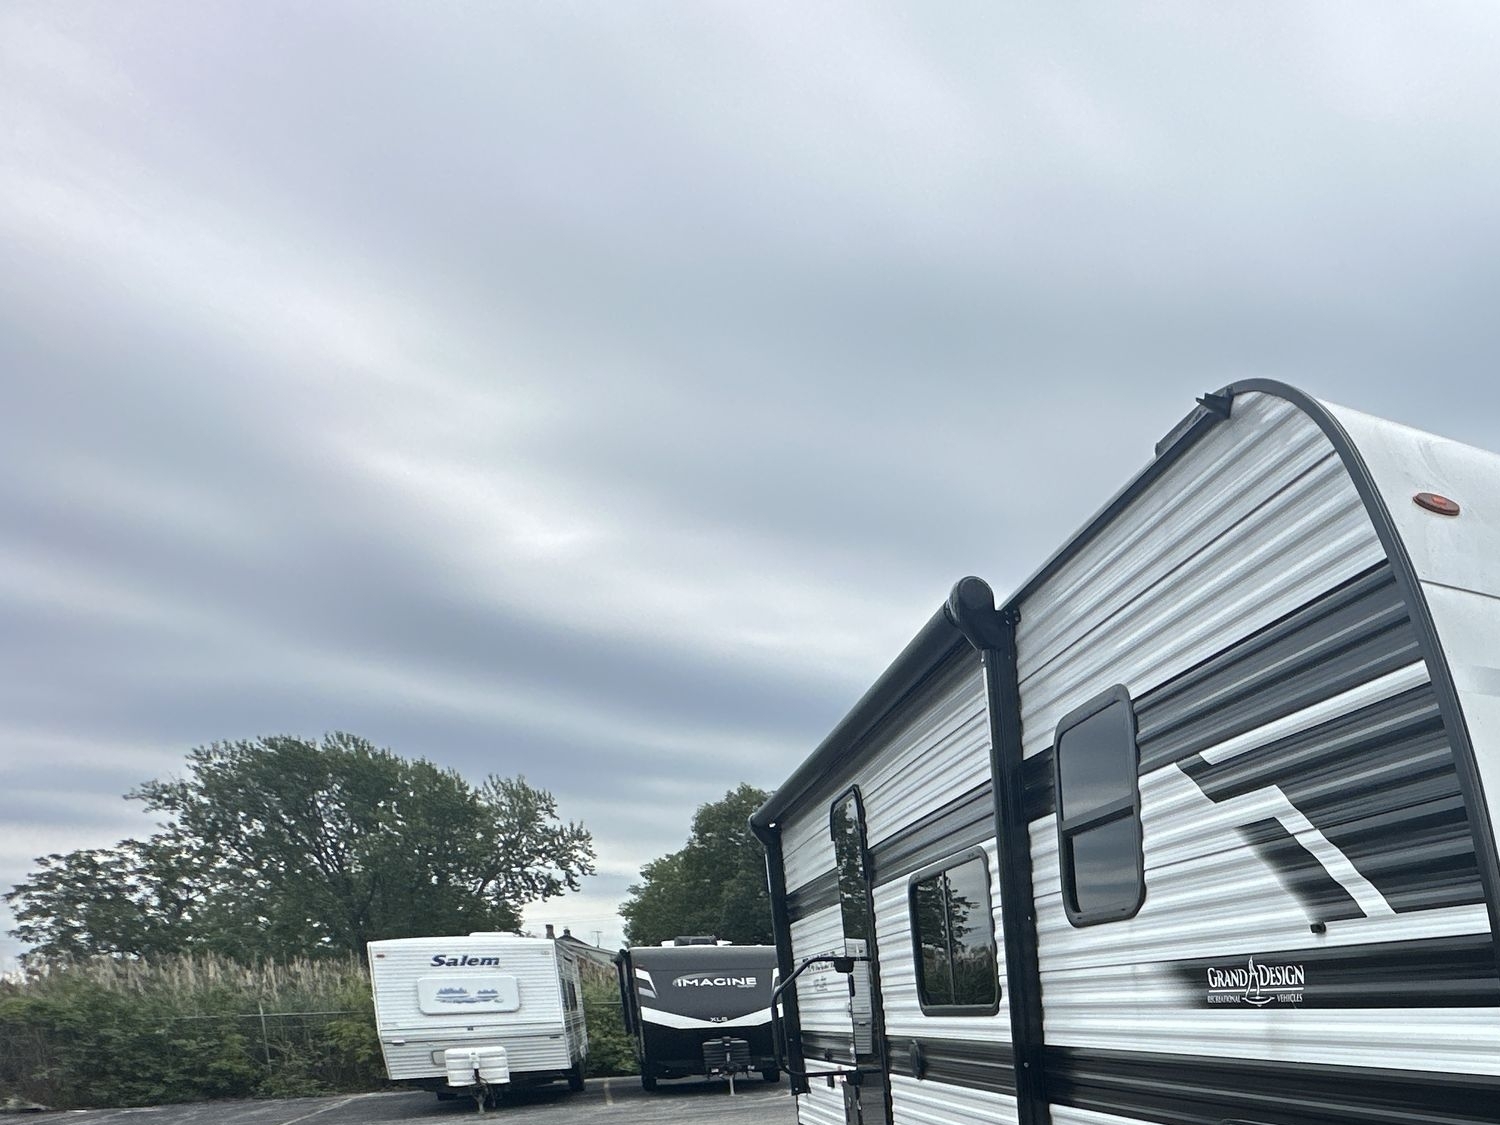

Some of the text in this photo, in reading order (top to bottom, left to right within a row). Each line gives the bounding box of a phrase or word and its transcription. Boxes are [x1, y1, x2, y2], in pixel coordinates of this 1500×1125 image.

[430, 954, 500, 967] Salem
[1207, 964, 1305, 988] GRAND DESIGN
[677, 977, 757, 987] IMAGINE
[1276, 993, 1303, 1003] VEHICLES
